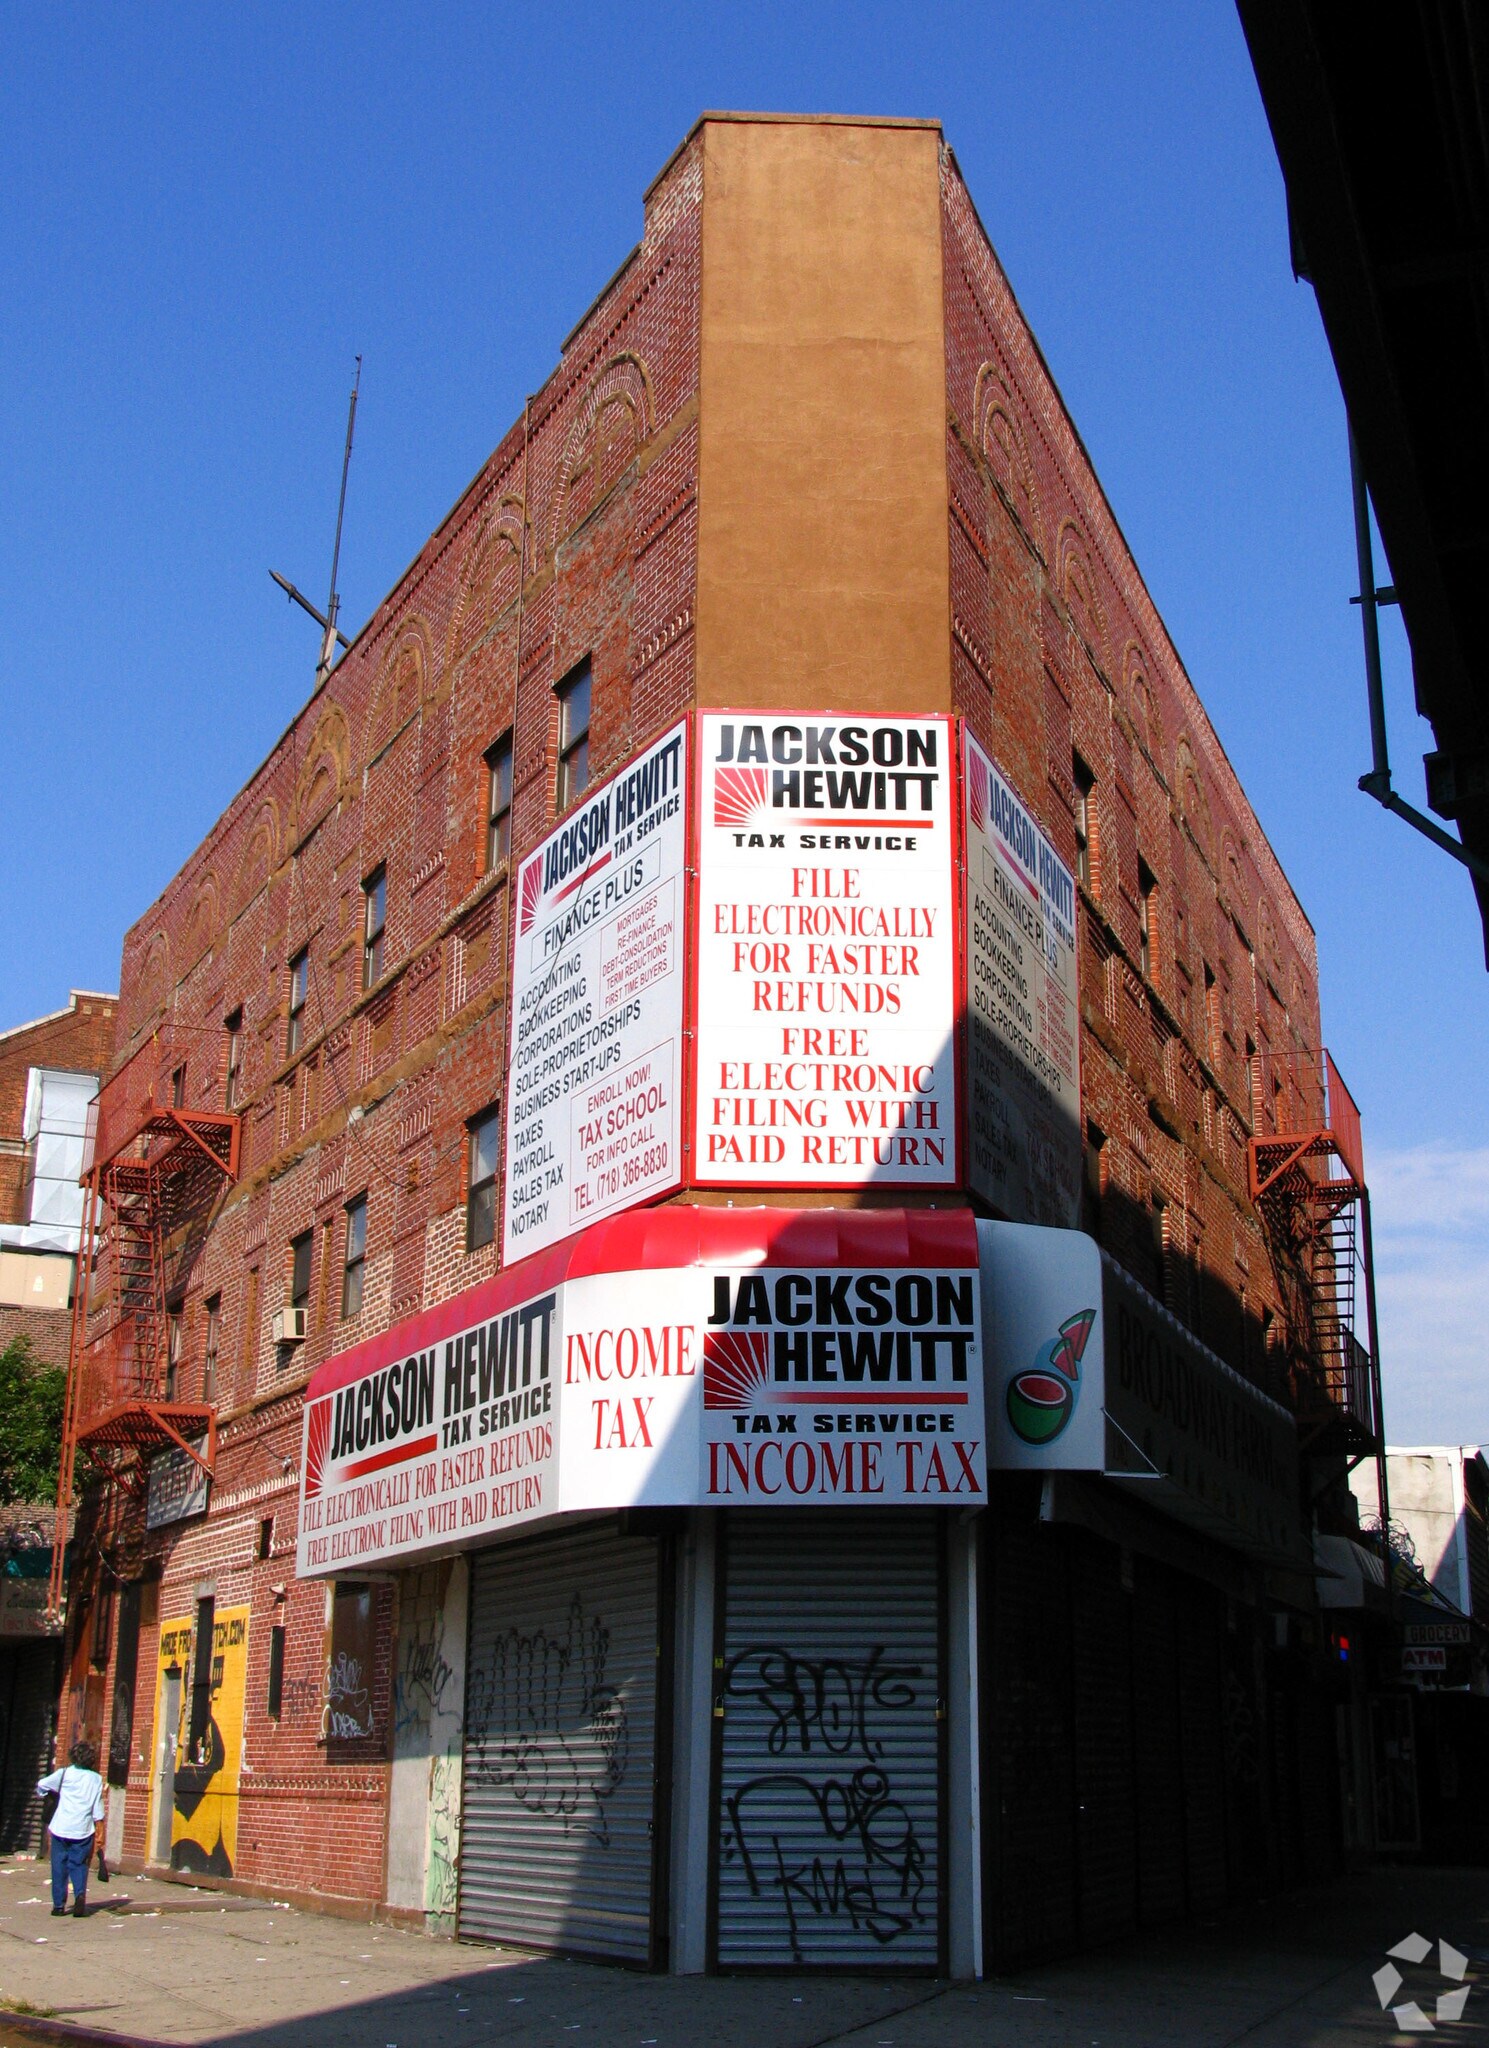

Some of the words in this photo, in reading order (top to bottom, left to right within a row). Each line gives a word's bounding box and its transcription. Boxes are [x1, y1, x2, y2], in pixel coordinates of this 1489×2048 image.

[715, 724, 937, 767] JACKSON
[544, 795, 611, 895] JACKSON
[615, 734, 682, 836] HEWITT
[772, 769, 939, 811] HEWITT
[614, 833, 633, 859] TAX
[636, 793, 680, 843] SERVICE
[732, 833, 786, 849] TAX
[799, 834, 917, 851] SERVICE
[988, 772, 1037, 878] JACKSON
[1039, 838, 1073, 927] HEWITT
[544, 889, 601, 957] FINANCE
[605, 859, 643, 910] PLUS
[791, 867, 861, 899] FILE
[616, 895, 658, 934] MORTGAGES
[617, 915, 656, 951] RE-FINANCE
[713, 903, 938, 938] ELECTRONICALLY
[974, 893, 1023, 966] ACCOUNTING
[993, 866, 1034, 940] FINANCE
[1035, 919, 1058, 969] PLUS
[602, 921, 673, 978] DEBT-CONSOLIDATION
[606, 963, 625, 990] TERM
[625, 940, 667, 981] REDUCTIONS
[732, 942, 792, 974] FOR
[806, 943, 920, 976] FASTER
[973, 921, 1028, 1000] BOOKKEEPING
[519, 952, 581, 1016] ACCOUNTING
[604, 989, 623, 1009] FIRST
[624, 978, 639, 1001] TIME
[639, 958, 668, 985] BUYERS
[752, 980, 901, 1014] REFUNDS
[974, 954, 1033, 1033] CORPORATIONS
[518, 977, 587, 1043] BOOKKEEPING
[515, 999, 641, 1097] SOLE-PROPRIETORSHIPS
[517, 1002, 592, 1070] CORPORATIONS
[780, 1027, 870, 1057] FREE
[974, 985, 1061, 1093] SOLE-PROPRIETORSHIPS
[514, 1080, 561, 1125] BUSINESS
[563, 1041, 622, 1094] START-UPS
[587, 1084, 623, 1114] ENROLL
[625, 1063, 651, 1092] NOW!
[718, 1061, 935, 1094] ELECTRONIC
[974, 1047, 1001, 1088] TAXES
[514, 1119, 544, 1154] TAXES
[578, 1115, 604, 1151] TAX
[606, 1082, 667, 1136] SCHOOL
[711, 1097, 828, 1128] FILING
[844, 1100, 940, 1130] WITH
[513, 1140, 554, 1182] PAYROLL
[586, 1148, 605, 1172] FOR
[606, 1136, 628, 1165] INFO
[630, 1122, 655, 1150] CALL
[707, 1134, 786, 1163] PAID
[801, 1135, 946, 1166] RETURN
[512, 1175, 543, 1209] SALES
[544, 1162, 564, 1190] TAX
[574, 1181, 595, 1212] TEL.
[597, 1166, 620, 1200] (718)
[622, 1141, 668, 1188] 366-8830
[511, 1200, 550, 1239] NOTARY
[708, 1275, 974, 1326] JACKSON
[331, 1349, 436, 1461] JACKSON
[443, 1292, 556, 1418] HEWITT
[564, 1324, 696, 1386] INCOME
[774, 1331, 974, 1382] HEWITT
[442, 1414, 472, 1450] TAX
[479, 1382, 552, 1437] SERVICE
[592, 1397, 654, 1450] TAX
[732, 1415, 797, 1434] TAX
[813, 1414, 955, 1434] SERVICE
[302, 1497, 323, 1534] FILE
[326, 1470, 412, 1530] ELECTRONICALLY
[415, 1461, 437, 1500] FOR
[441, 1445, 485, 1493] FASTER
[489, 1421, 553, 1478] REFUNDS
[706, 1440, 885, 1495] INCOME
[896, 1441, 982, 1494] TAX
[306, 1535, 329, 1567] FREE
[331, 1519, 387, 1560] ELECTRONIC
[389, 1509, 424, 1546] FILING
[427, 1499, 457, 1538] WITH
[460, 1490, 488, 1528] PAID
[491, 1473, 543, 1519] RETURN
[1404, 1650, 1445, 1665] ATM
[1410, 1624, 1470, 1643] GROCERY
